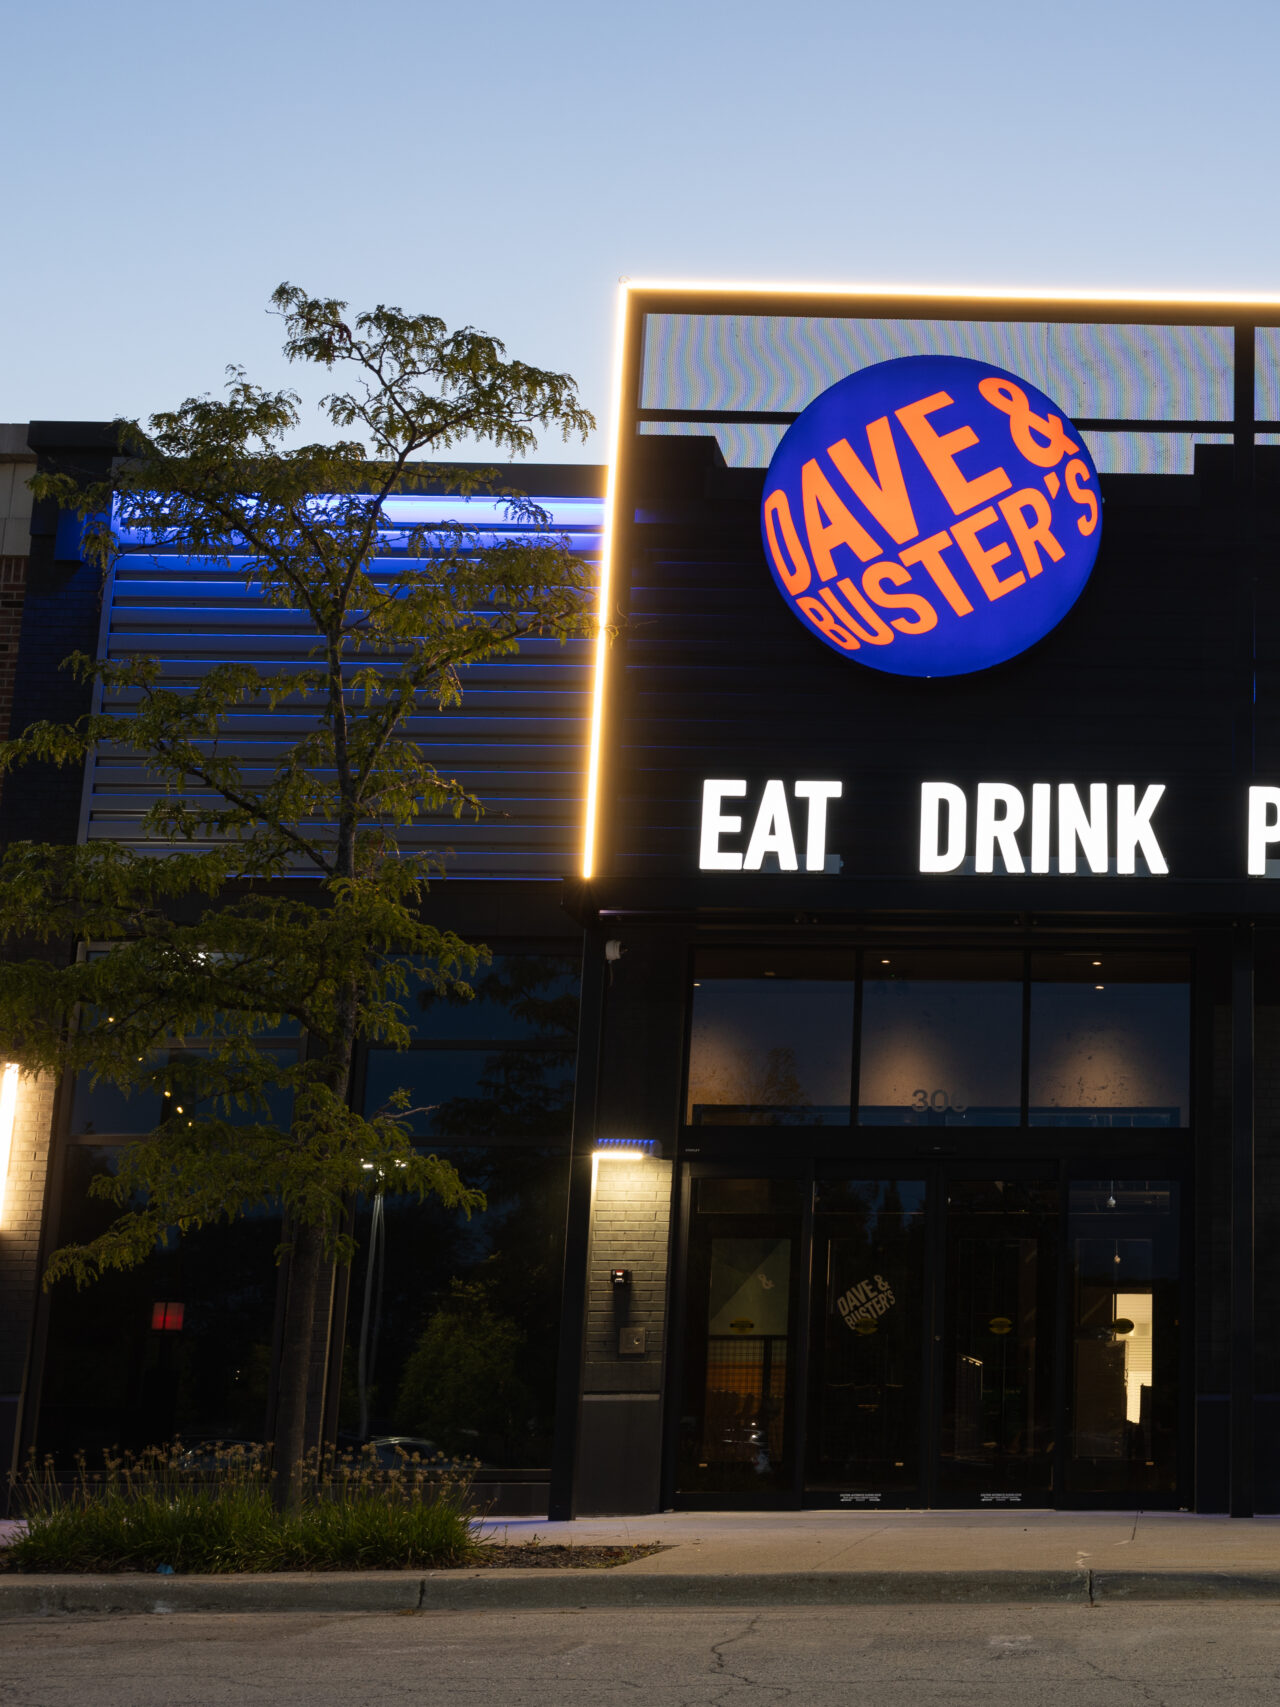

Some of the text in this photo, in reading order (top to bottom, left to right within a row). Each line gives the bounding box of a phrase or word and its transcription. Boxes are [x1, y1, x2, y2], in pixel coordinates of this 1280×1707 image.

[764, 377, 1080, 596] DAVE &
[796, 458, 1098, 650] BUSTER'S
[699, 779, 842, 871] EAT
[919, 782, 1169, 874] DRINK
[836, 1274, 891, 1316] DAVE &
[844, 1290, 896, 1330] BUSTER'S
